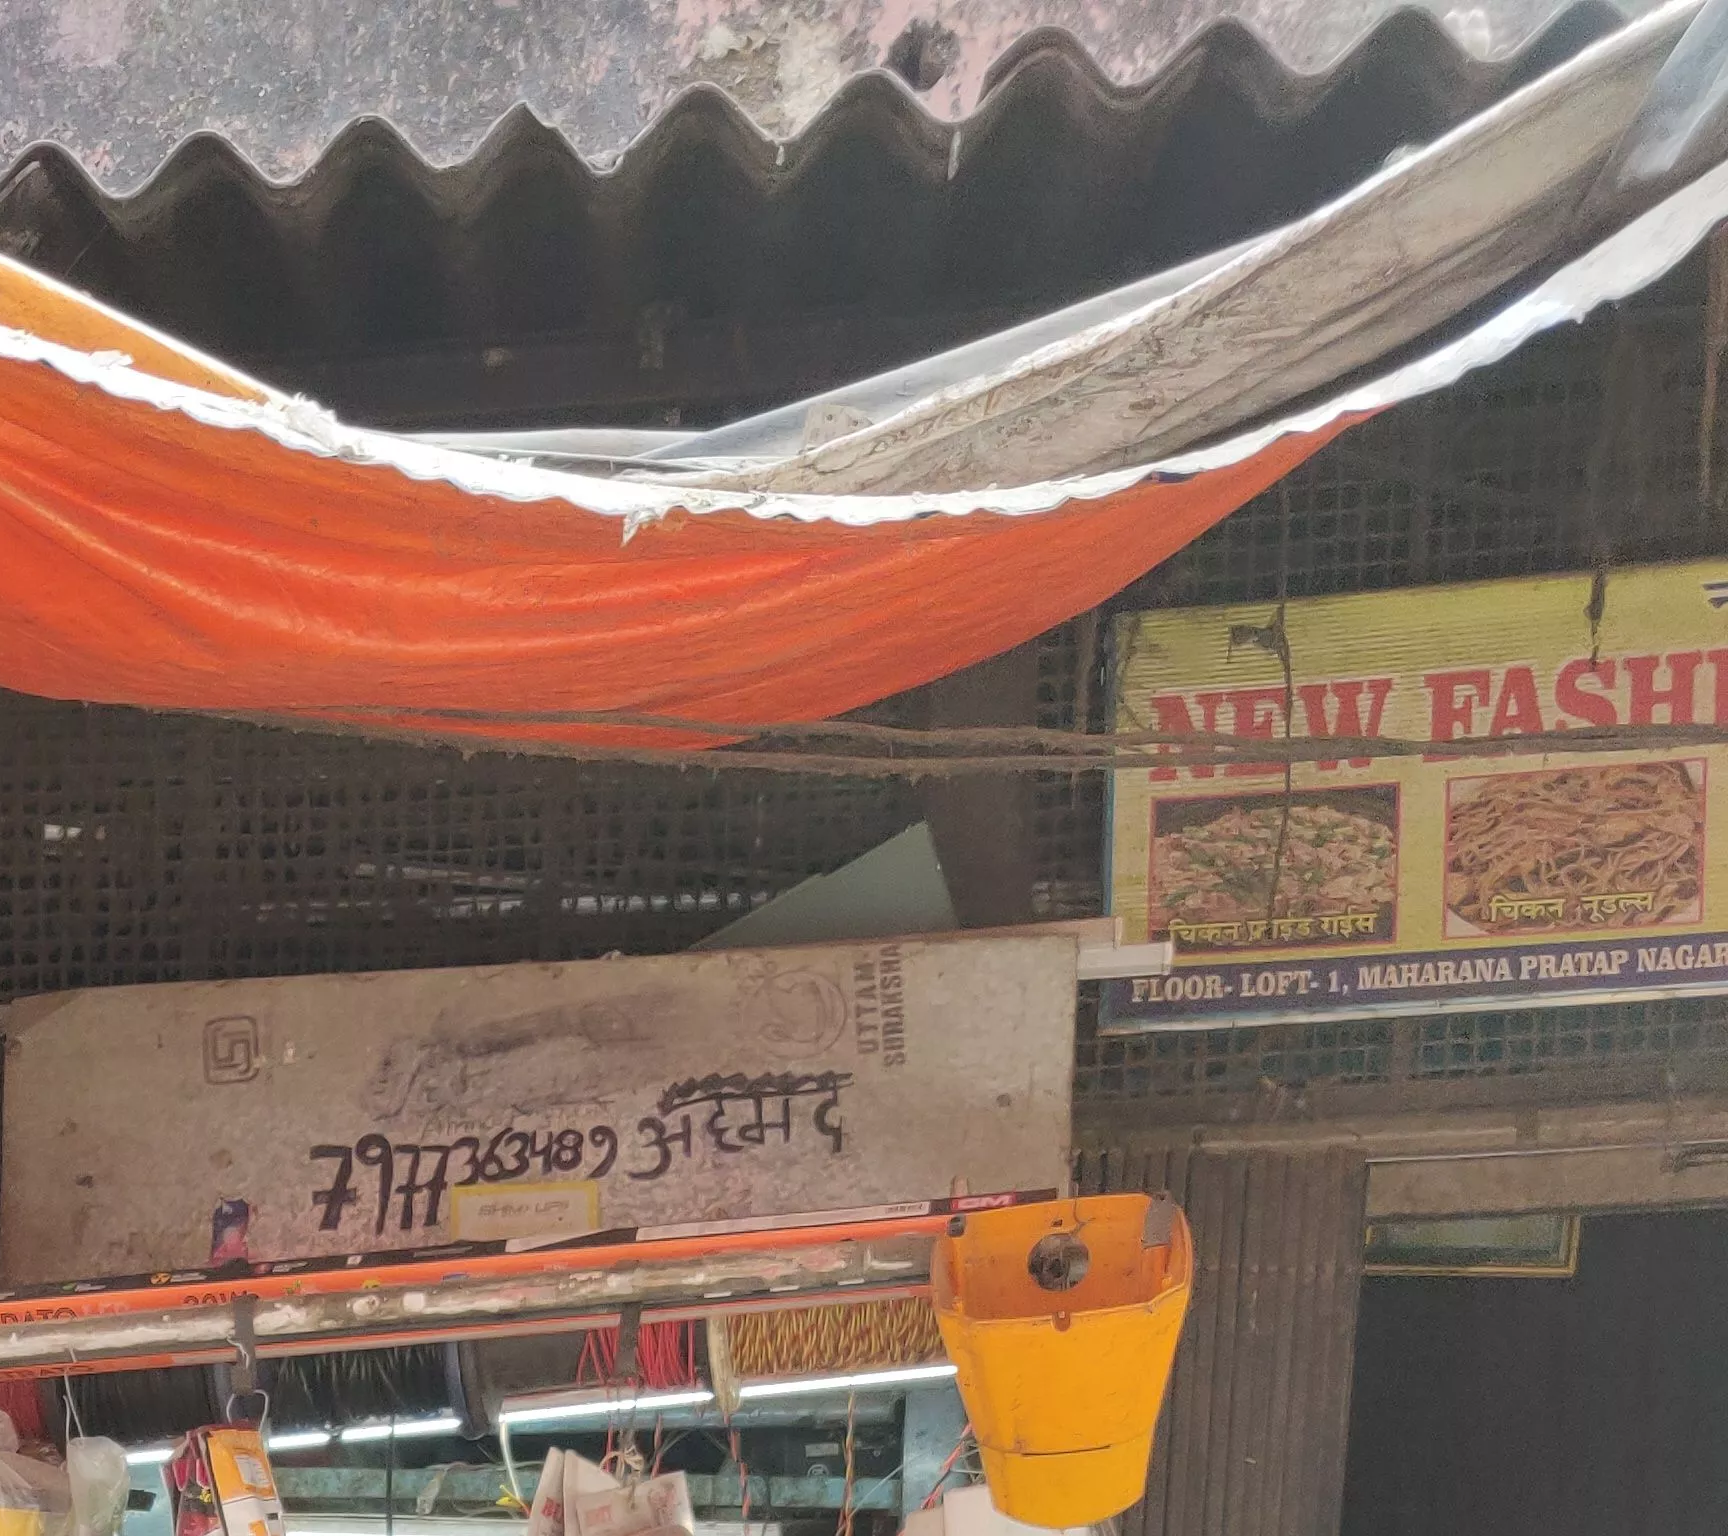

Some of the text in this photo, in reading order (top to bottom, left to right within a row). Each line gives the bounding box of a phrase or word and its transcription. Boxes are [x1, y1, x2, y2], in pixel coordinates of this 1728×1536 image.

[1148, 678, 1393, 782] NEW
[1489, 894, 1566, 922] चिकन
[854, 961, 879, 1054] UTTAM
[1357, 957, 1513, 991] MAHARANA
[1519, 949, 1629, 980] PRATAP
[309, 1124, 618, 1234] 7977363489
